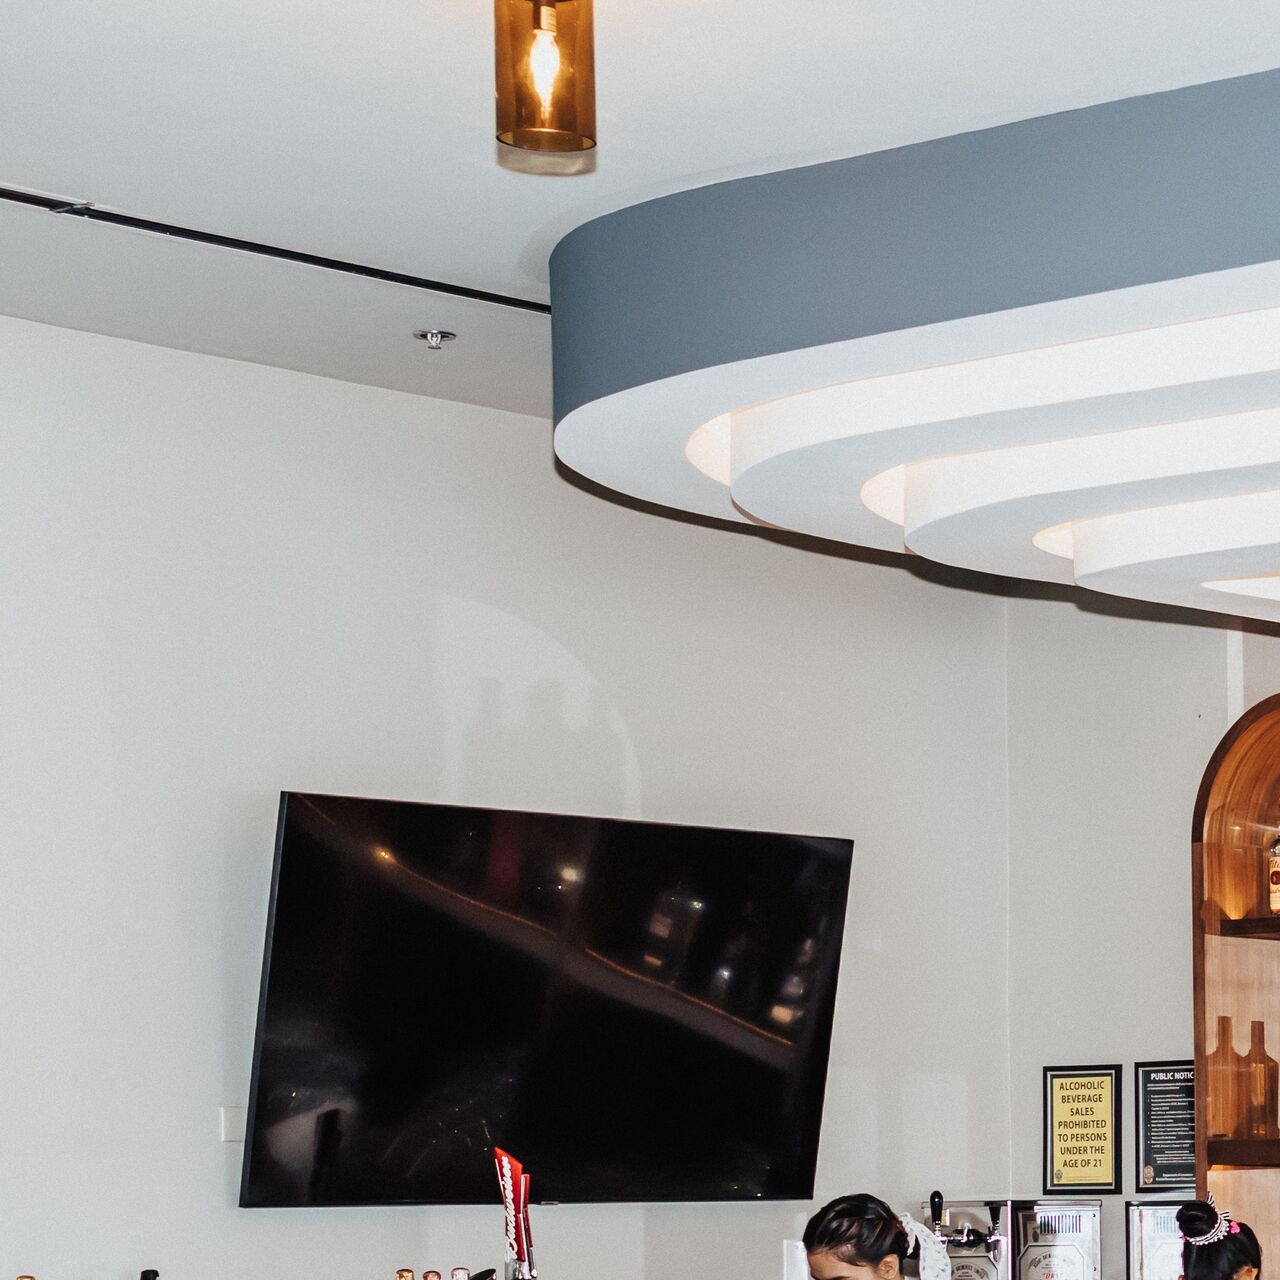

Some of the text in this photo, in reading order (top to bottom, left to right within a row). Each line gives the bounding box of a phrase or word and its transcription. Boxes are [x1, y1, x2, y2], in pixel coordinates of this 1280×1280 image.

[1174, 1072, 1194, 1080] NOTIC
[1060, 1081, 1104, 1091] ALCOHOLIC
[1062, 1094, 1102, 1104] BEVERAGE
[1070, 1107, 1094, 1116] SALES
[1058, 1120, 1106, 1130] PROHIBITED
[1058, 1132, 1107, 1142] TO PERSONS
[1060, 1146, 1104, 1155] UNDER THE
[1062, 1158, 1102, 1168] AGE OF 21
[501, 1156, 518, 1263] Budweiser
